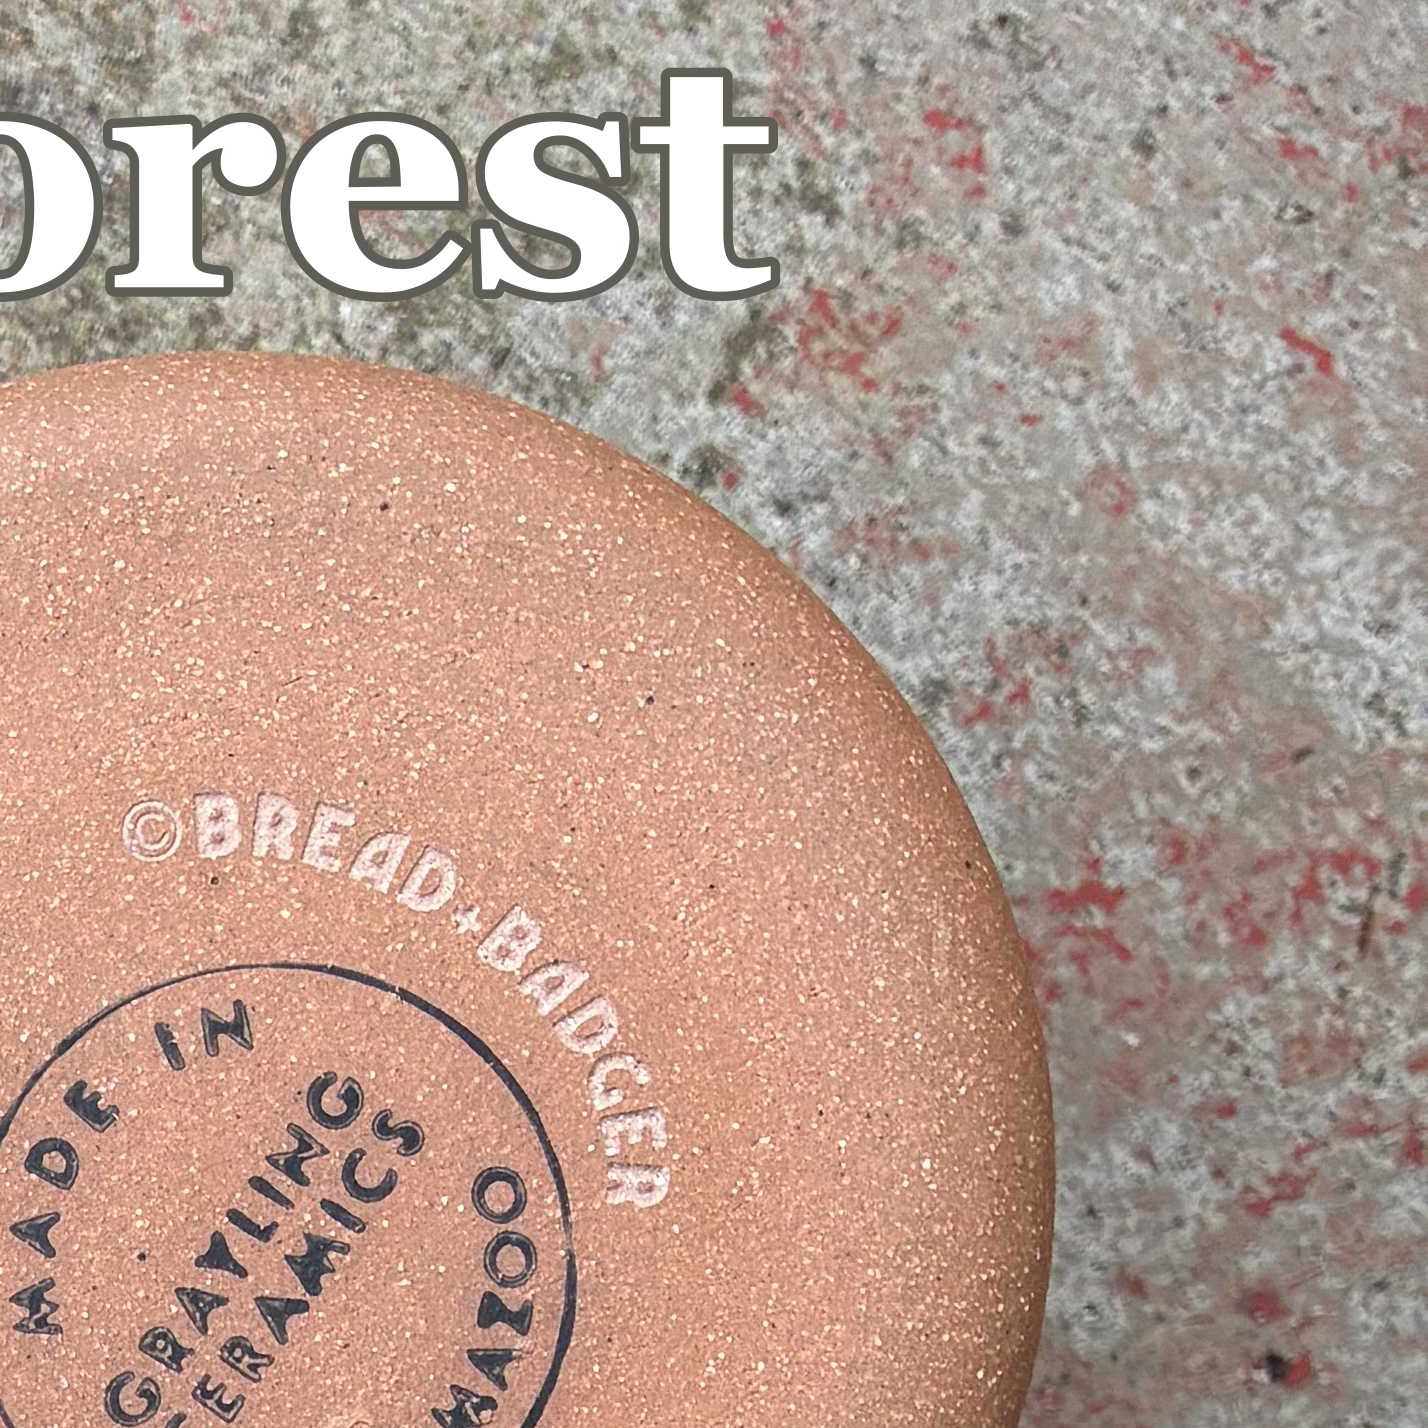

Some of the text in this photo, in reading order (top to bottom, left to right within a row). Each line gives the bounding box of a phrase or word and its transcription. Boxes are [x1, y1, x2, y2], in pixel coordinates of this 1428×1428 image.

[9, 999, 254, 1336] MADE IN
[103, 1070, 366, 1428] GRAYLING
